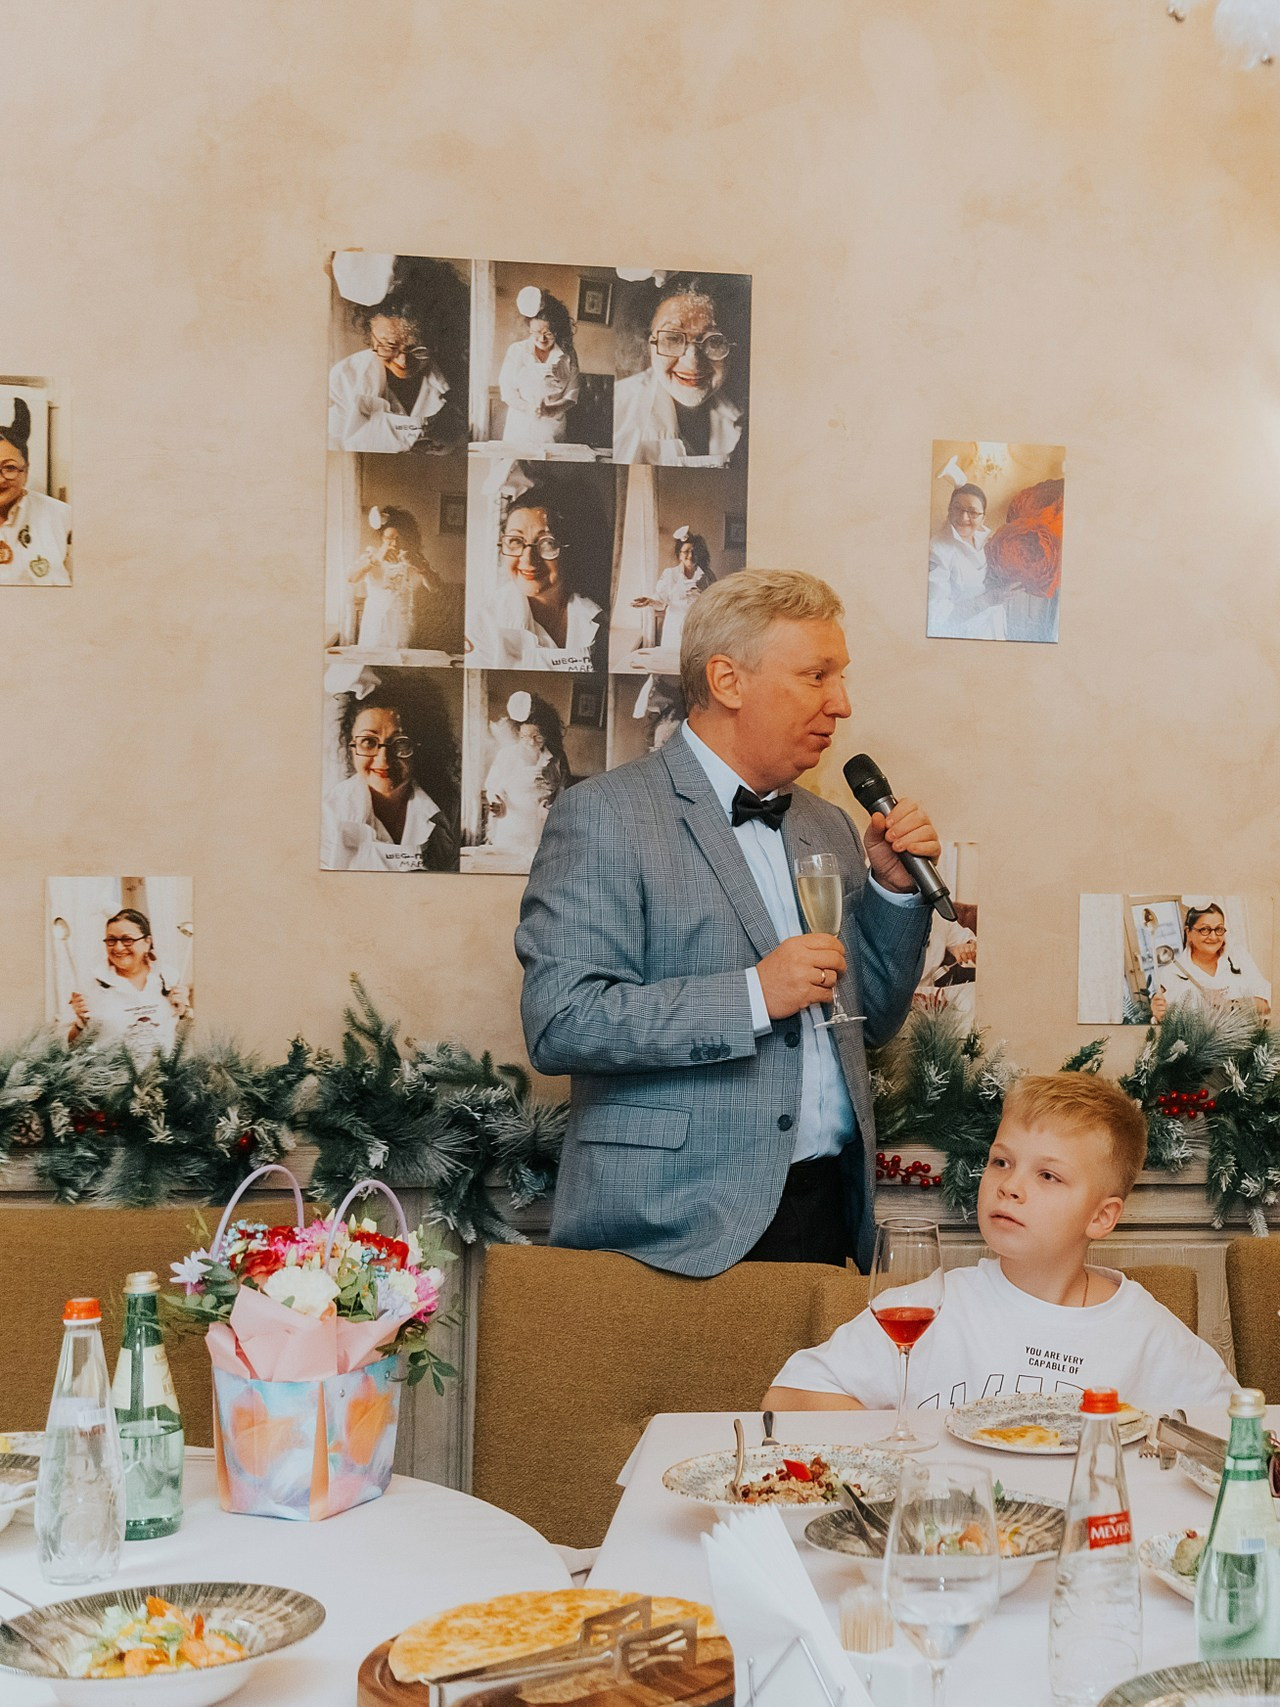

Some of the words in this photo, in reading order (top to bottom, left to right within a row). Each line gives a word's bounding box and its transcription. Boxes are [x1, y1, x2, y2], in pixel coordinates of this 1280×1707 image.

[1025, 1346, 1042, 1357] YOU
[1044, 1350, 1061, 1361] ARE
[1063, 1354, 1084, 1365] VERY
[1028, 1357, 1067, 1372] CAPABLE
[1068, 1365, 1080, 1375] OF
